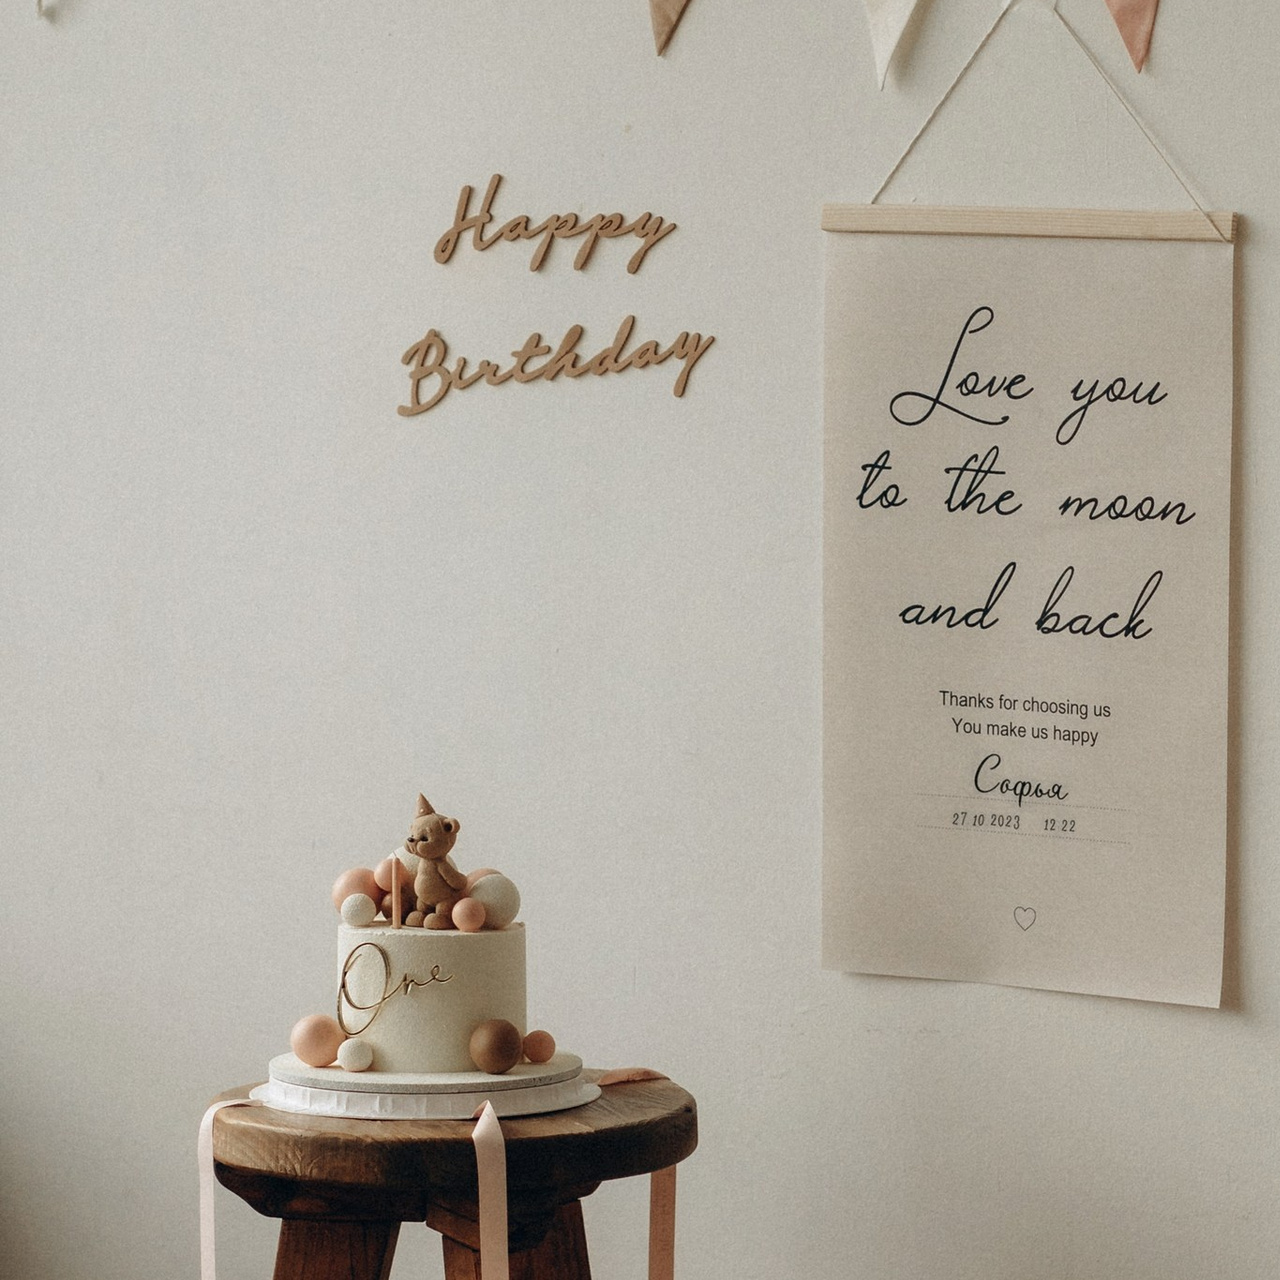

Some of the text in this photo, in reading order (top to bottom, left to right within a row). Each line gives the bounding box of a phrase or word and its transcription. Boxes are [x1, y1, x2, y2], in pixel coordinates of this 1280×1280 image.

[433, 173, 678, 275] Happy
[396, 314, 716, 417] Birthday
[889, 306, 1168, 446] Love you
[855, 445, 1196, 526] to the moon
[898, 561, 1164, 640] and back
[938, 689, 1112, 720] Thanks for choosing us
[951, 717, 1099, 748] You make us happy
[973, 752, 1069, 808] Софья
[951, 811, 968, 826] 27
[972, 813, 986, 827] 10
[990, 813, 1021, 830] 2023
[336, 941, 454, 1036] One
